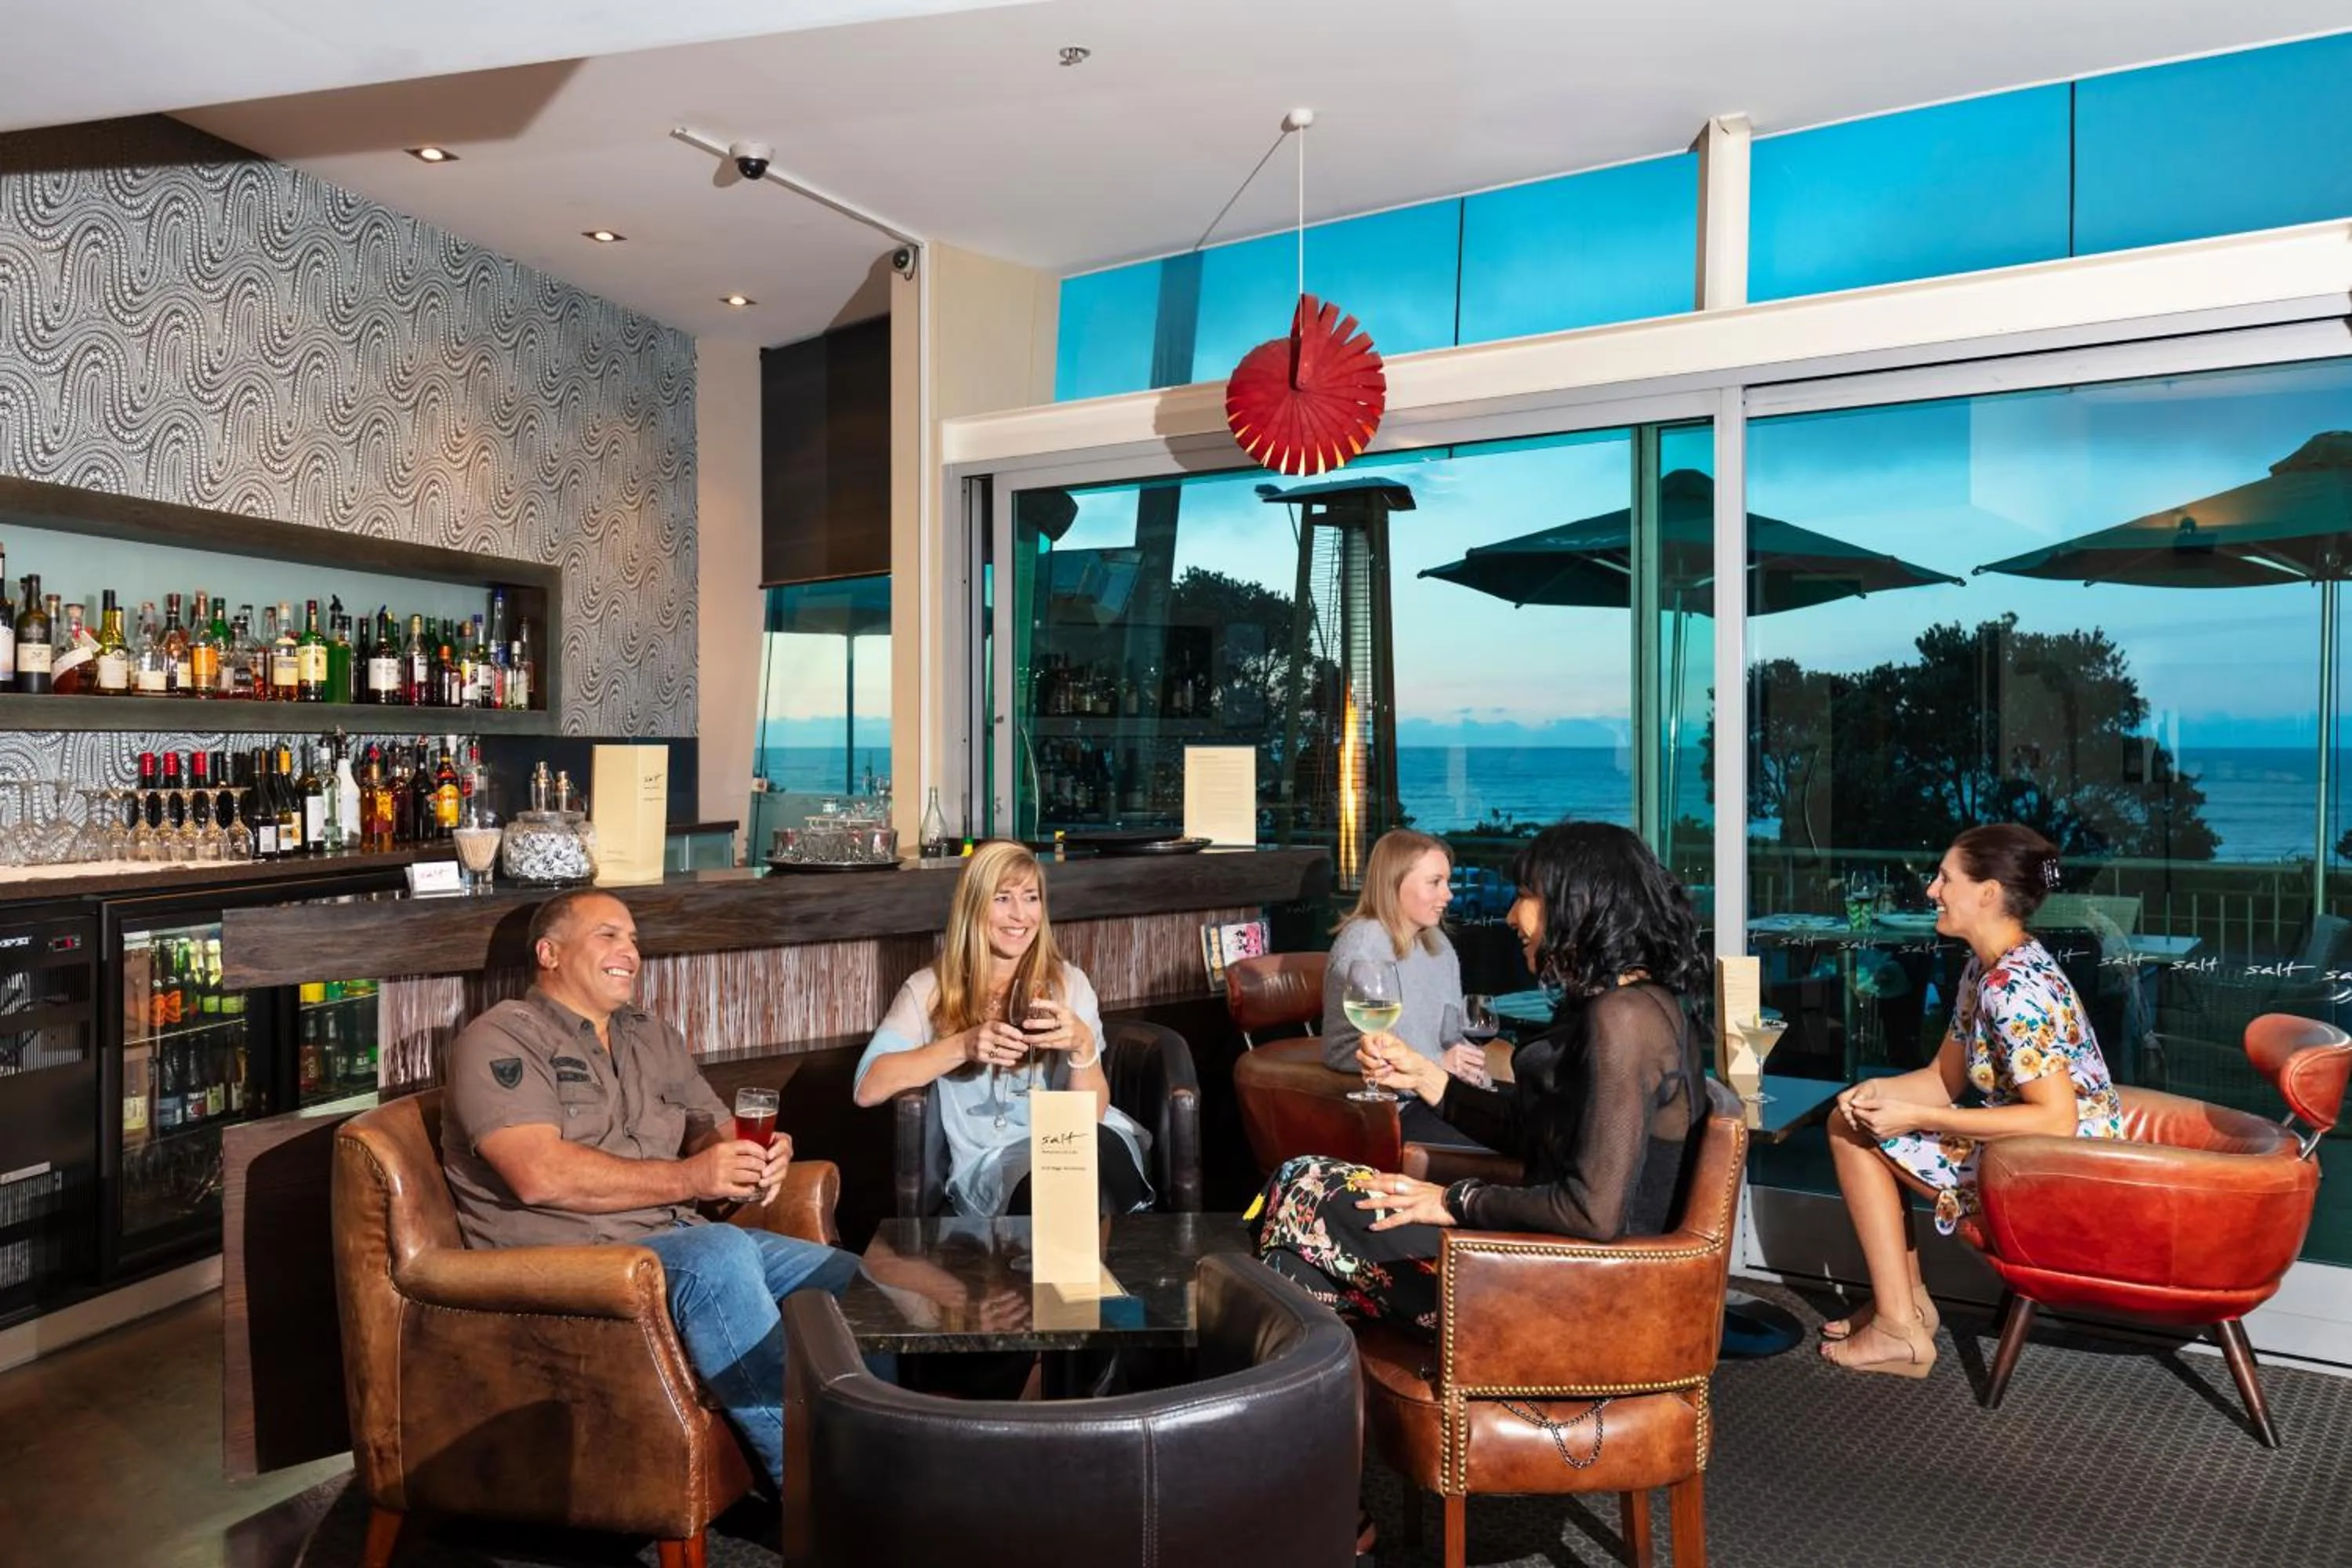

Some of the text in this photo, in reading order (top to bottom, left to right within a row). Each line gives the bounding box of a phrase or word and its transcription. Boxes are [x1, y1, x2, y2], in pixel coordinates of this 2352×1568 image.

[1463, 914, 1506, 927] salt
[1780, 935, 1829, 948] salt
[1838, 938, 1885, 950] salt
[1899, 940, 1957, 954] salt
[2057, 949, 2090, 964] lt
[2098, 953, 2158, 967] salt
[2170, 956, 2219, 972] salt
[2245, 961, 2316, 977] salt
[2323, 970, 2352, 981] sa
[1041, 1131, 1088, 1145] salt
